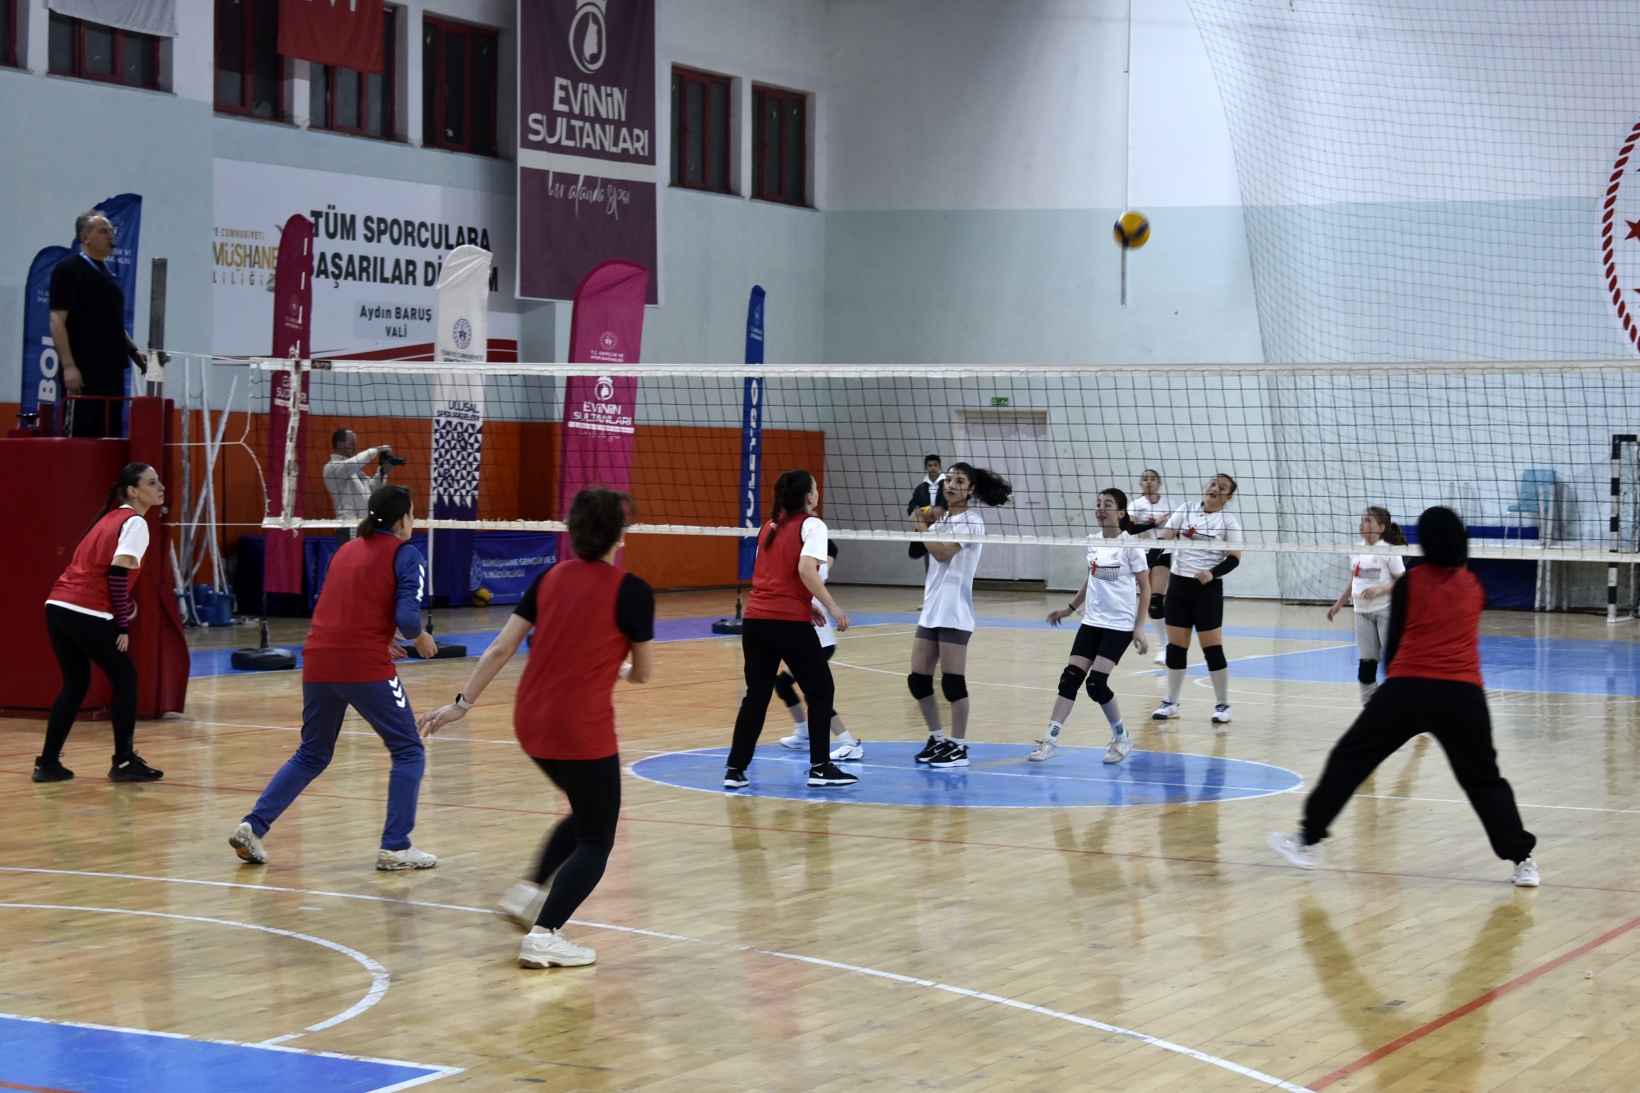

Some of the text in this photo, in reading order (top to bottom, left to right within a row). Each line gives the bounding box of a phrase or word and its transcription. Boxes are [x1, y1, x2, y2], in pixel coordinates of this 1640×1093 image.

[527, 112, 649, 157] SULTANLARI
[310, 204, 491, 251] TÜM SPORCULARA
[311, 251, 417, 289] AŞARILAR
[359, 304, 432, 324] Aydın BARUŞ
[385, 324, 408, 338] VALİ
[572, 411, 632, 426] SULTANLARI
[744, 362, 760, 540] VOLEYBO
